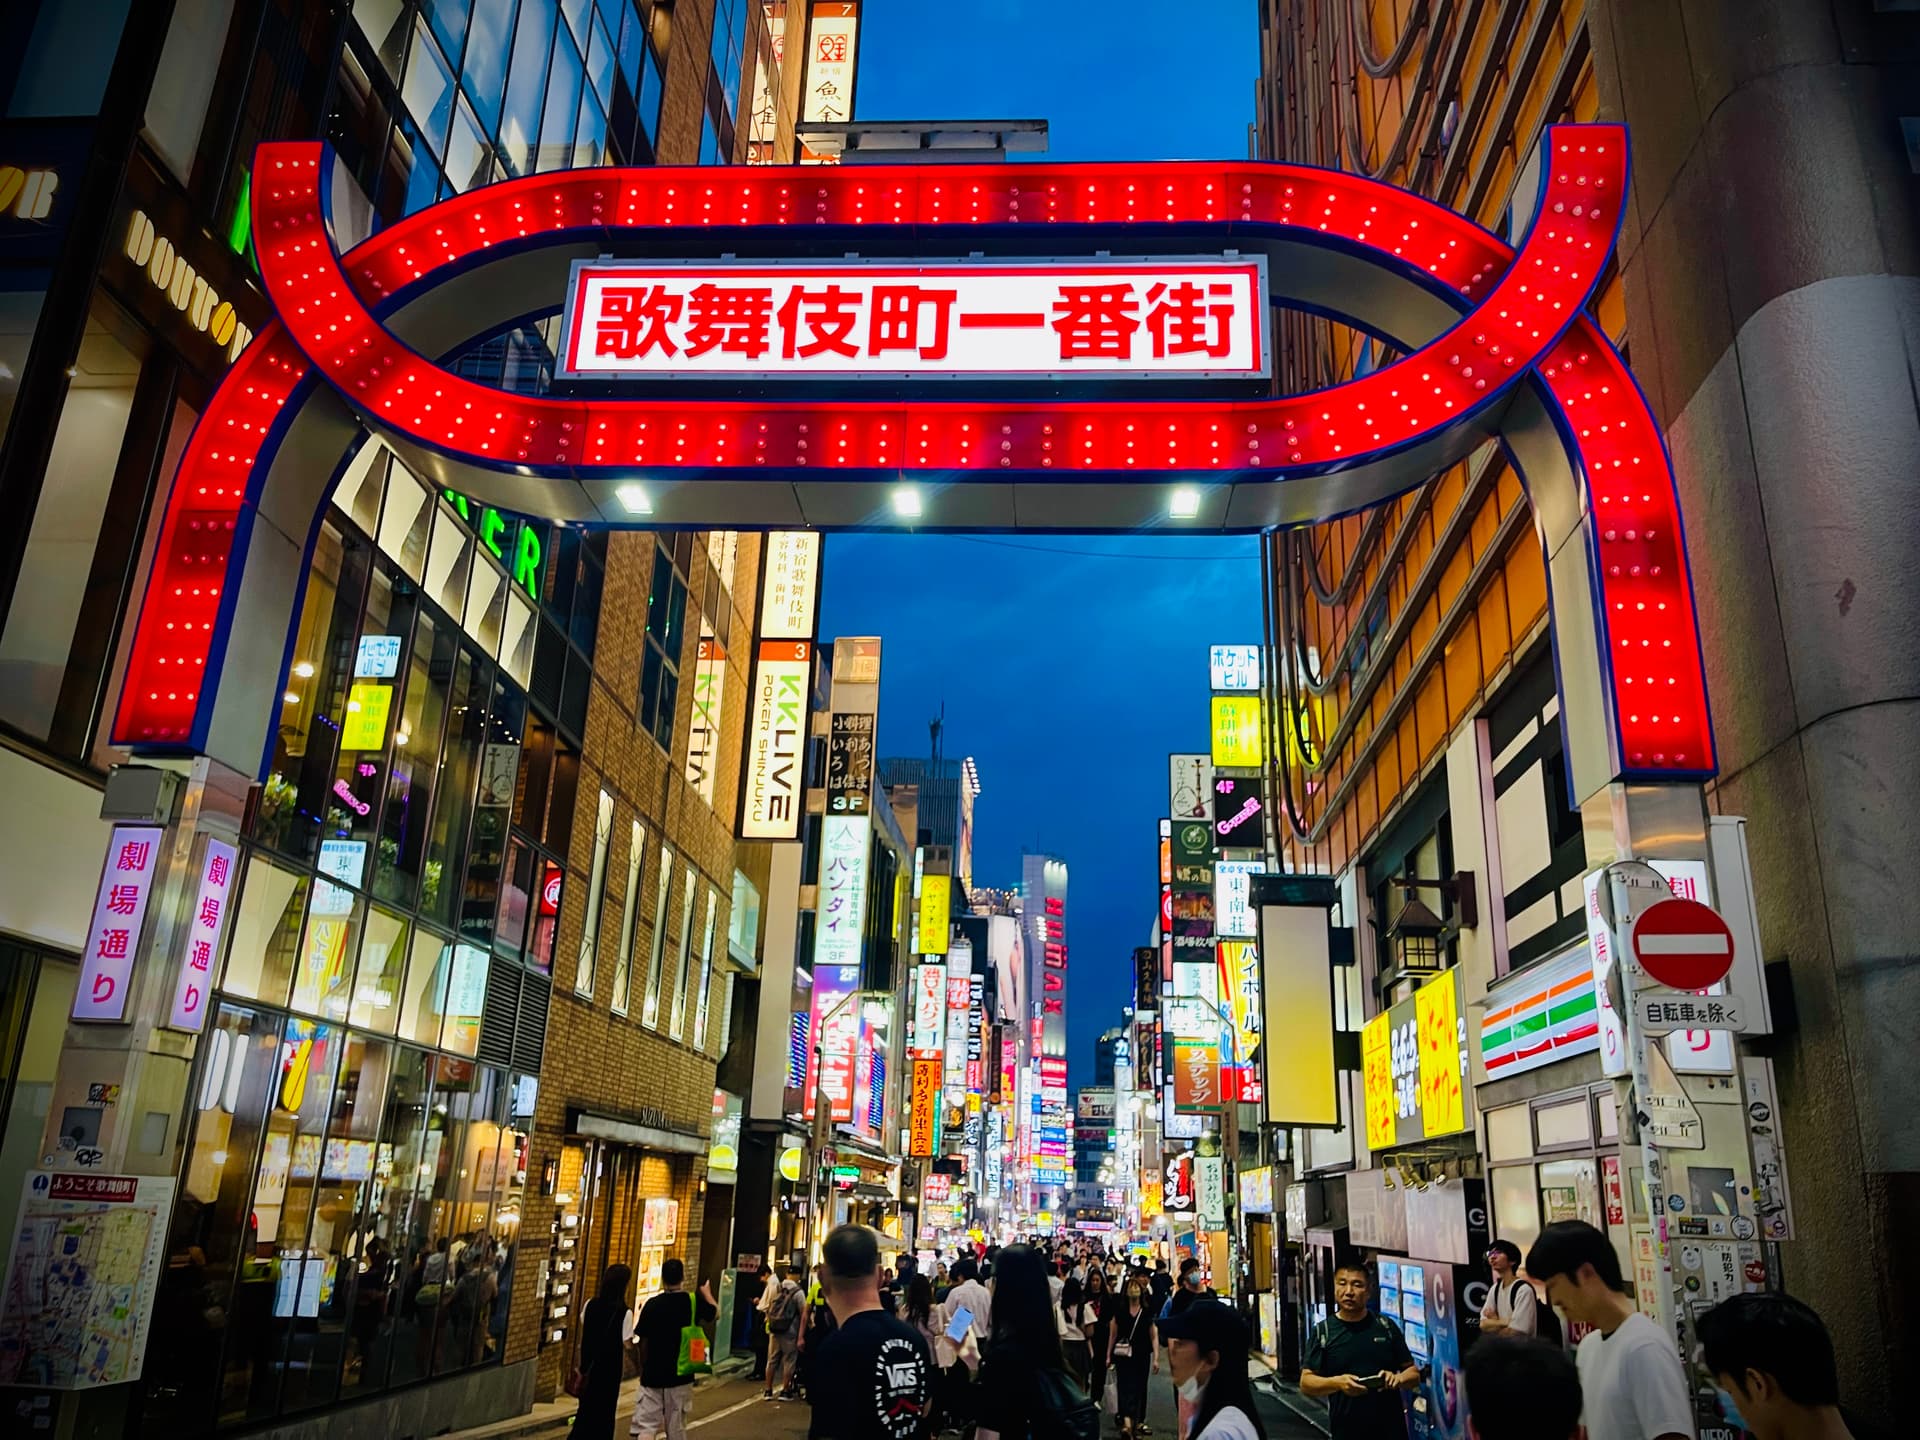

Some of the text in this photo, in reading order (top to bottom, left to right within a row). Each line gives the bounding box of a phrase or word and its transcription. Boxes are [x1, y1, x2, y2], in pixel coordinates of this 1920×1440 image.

[841, 5, 852, 16] 7
[816, 81, 843, 122] 魚金
[595, 282, 1235, 361] 歌舞伎町一番街
[788, 537, 808, 630] 新宿歌舞伎町
[794, 644, 805, 659] 3
[1213, 649, 1256, 668] ポケット
[1223, 670, 1248, 688] ビル
[833, 715, 873, 731] 小料理
[753, 674, 774, 823] POKER SHINJUKU
[768, 674, 801, 822] KKLIVE
[1216, 780, 1235, 794] 4F
[832, 796, 864, 811] 3F
[1228, 877, 1246, 934] 東南荘
[91, 840, 150, 1004] 劇場通り
[183, 854, 229, 1013] 劇場通り
[839, 967, 858, 982] 2F
[1646, 1002, 1738, 1024] 自転車を除く
[885, 1362, 919, 1389] VANS
